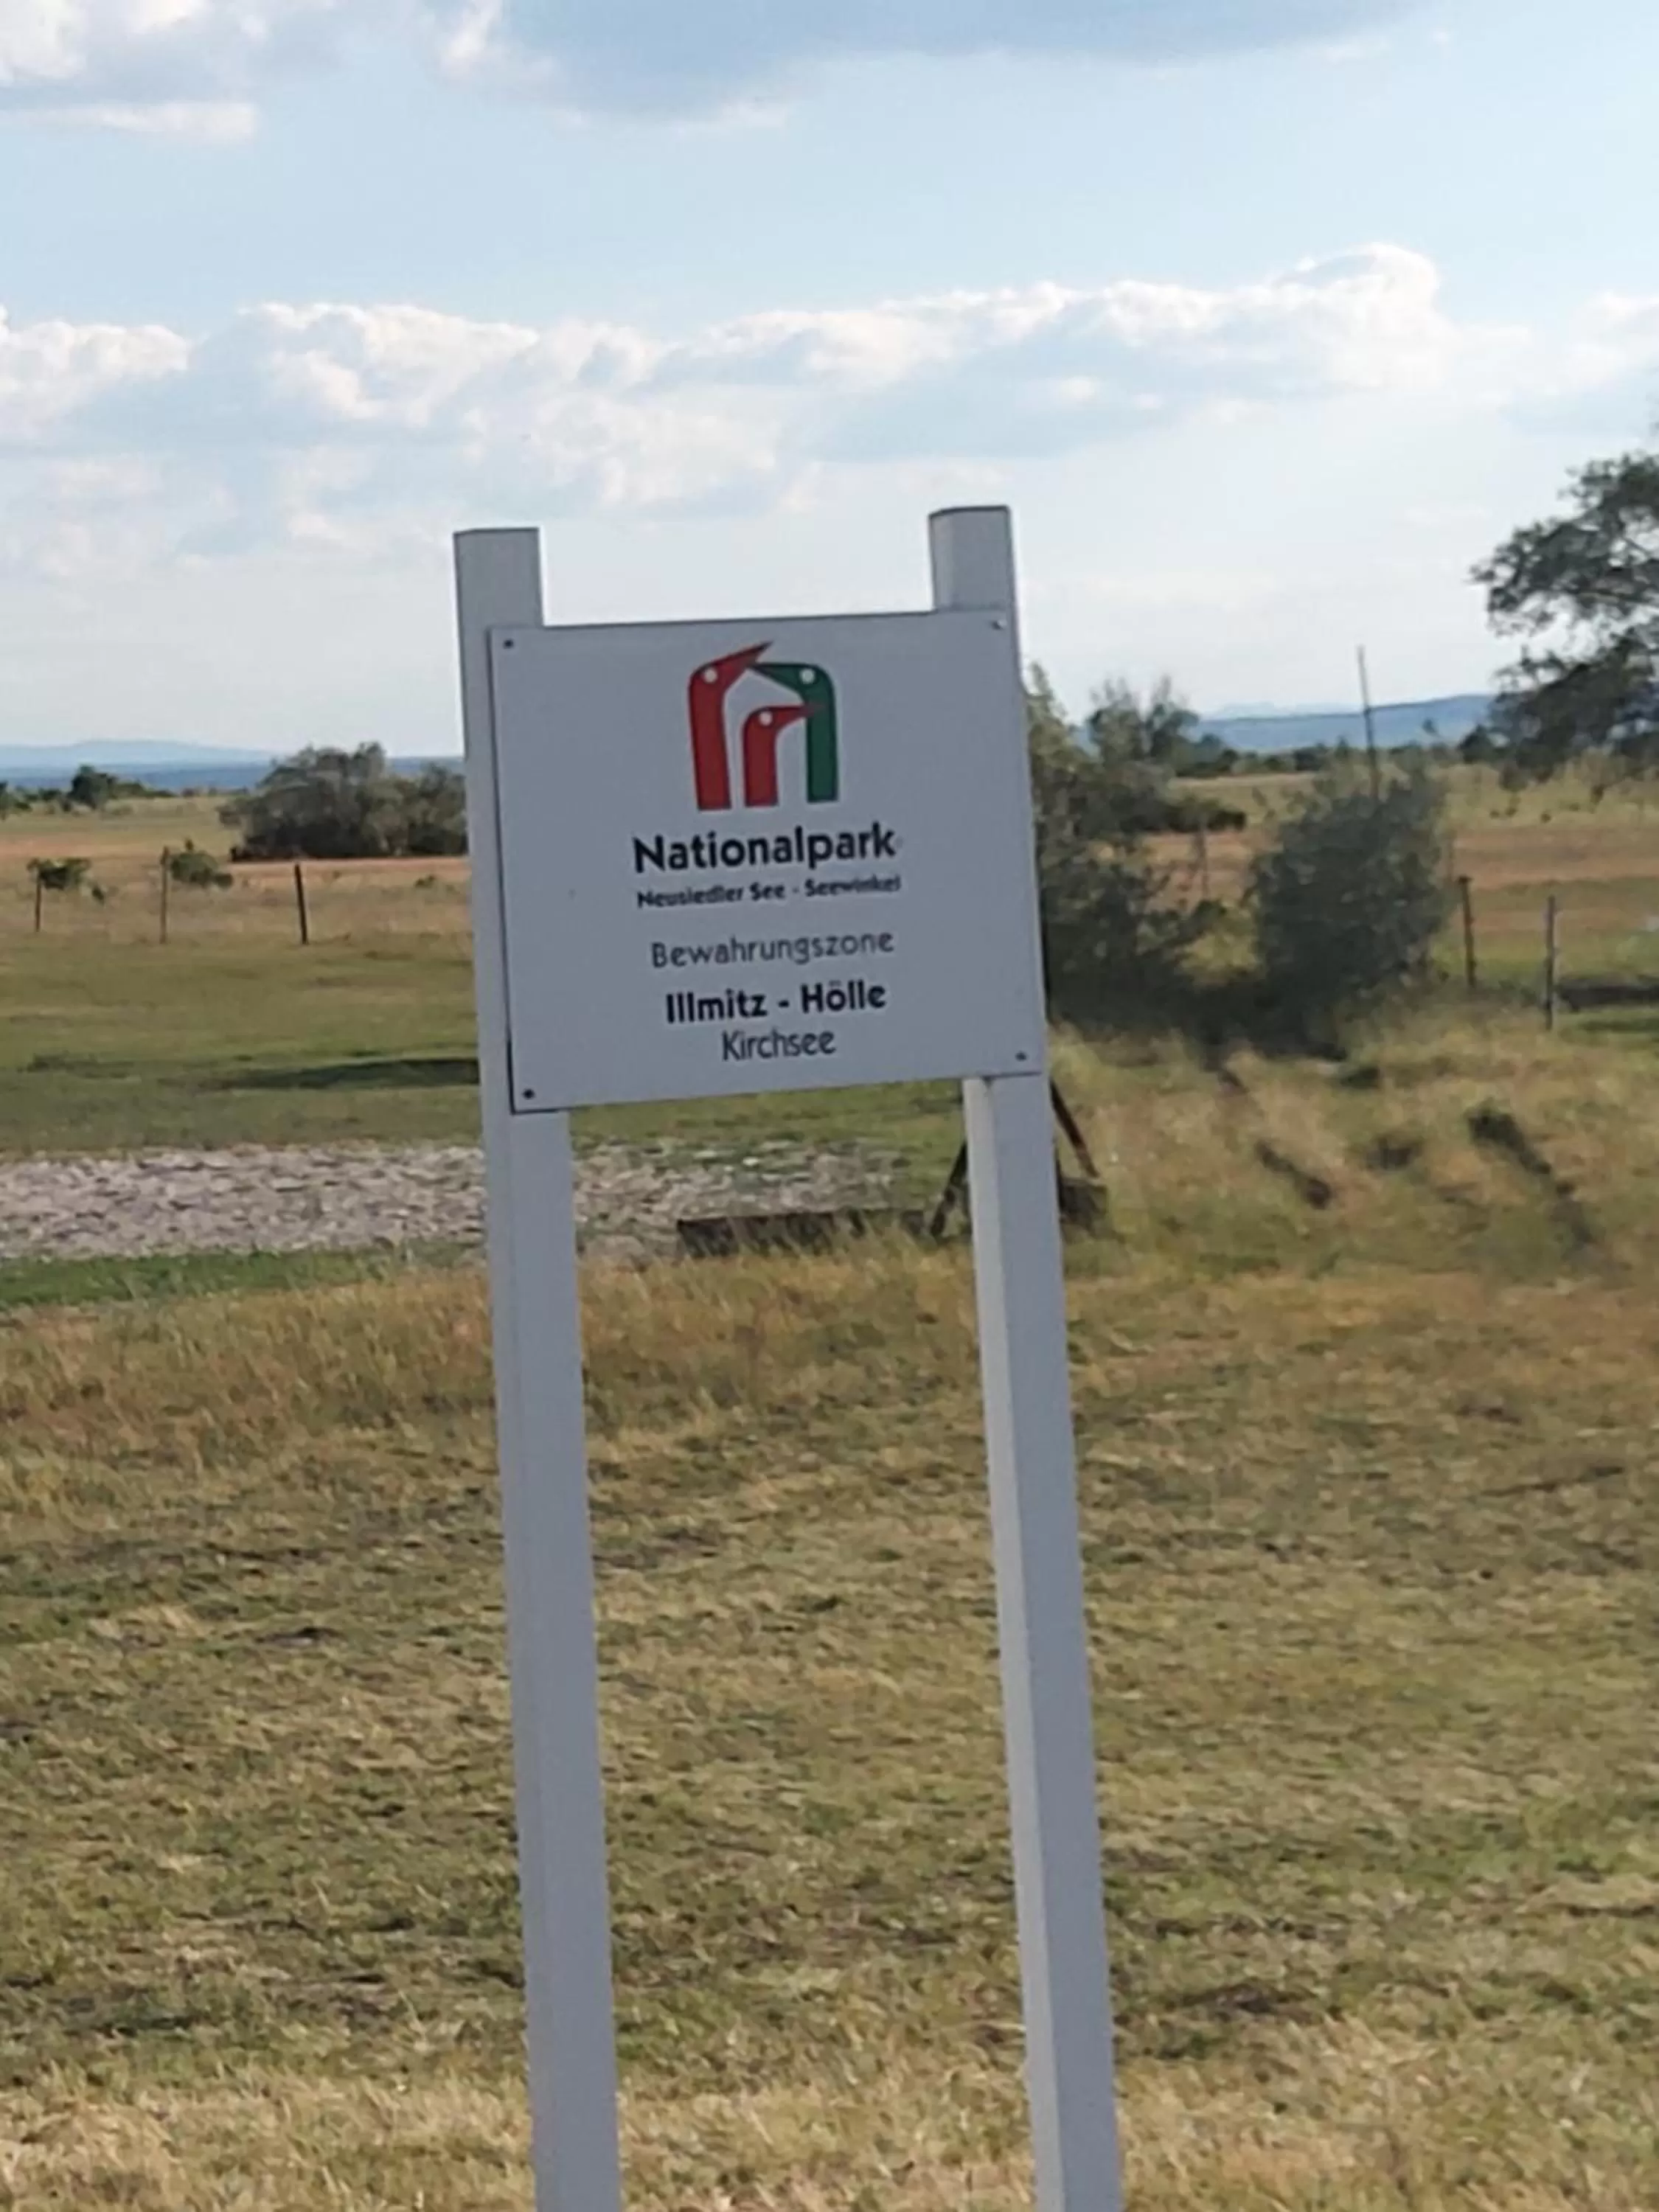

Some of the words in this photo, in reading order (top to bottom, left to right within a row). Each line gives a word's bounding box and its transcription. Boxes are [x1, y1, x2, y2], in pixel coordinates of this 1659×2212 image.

[632, 821, 897, 874] Nationalpark
[749, 882, 785, 901] See
[651, 933, 894, 968] Bewahrungszone
[665, 988, 768, 1024] Illmitz
[800, 979, 886, 1014] Hölle
[721, 1028, 837, 1061] Kirchsee
